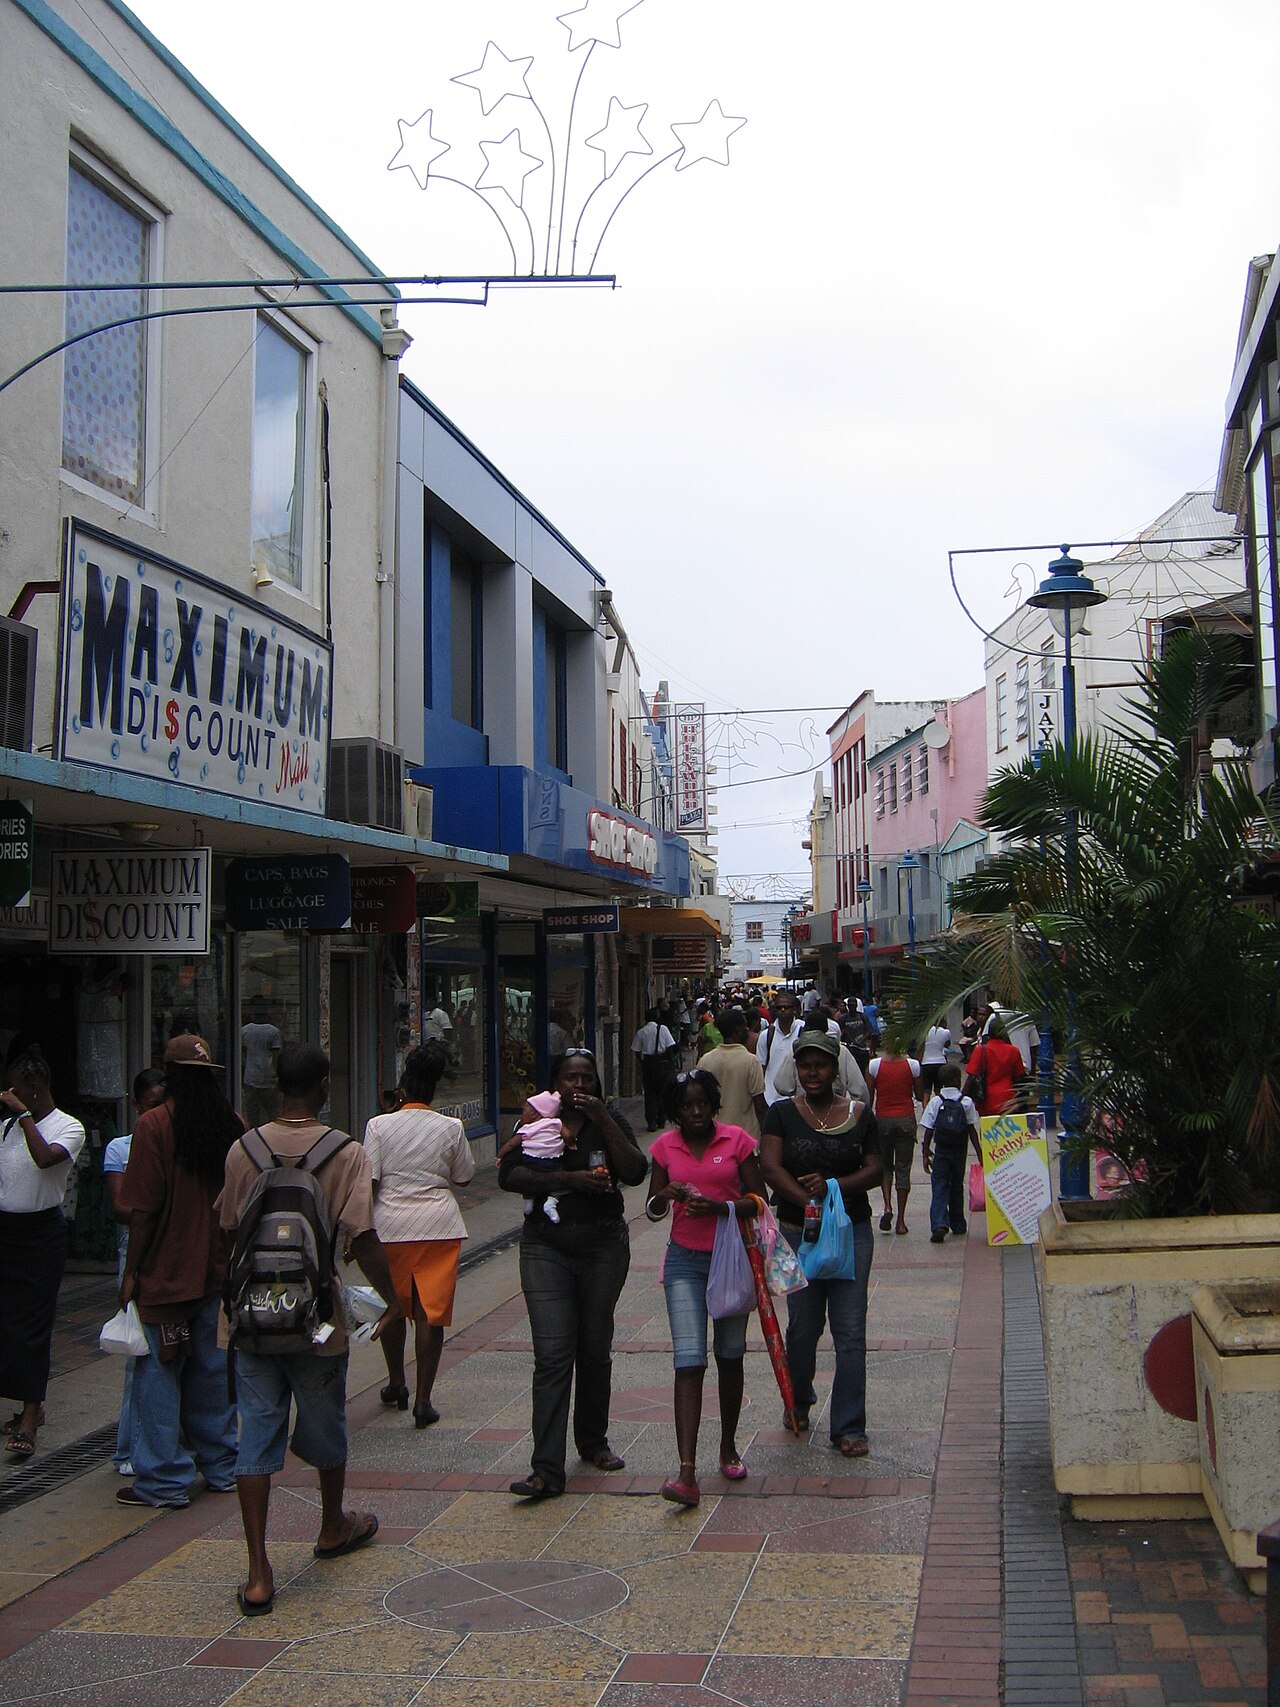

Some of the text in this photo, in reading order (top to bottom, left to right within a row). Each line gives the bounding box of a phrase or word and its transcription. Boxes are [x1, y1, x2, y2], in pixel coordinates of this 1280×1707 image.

[81, 563, 325, 741] MAXIMUM
[128, 685, 310, 794] DI$COUNT Mall
[0, 818, 26, 836] RIES
[591, 812, 658, 874] SHOE SHOP
[58, 857, 201, 896] MAXIMUM
[291, 865, 329, 880] BAGS
[282, 882, 293, 895] &
[249, 894, 326, 911] LUGGAGE
[265, 916, 309, 930] SALE
[547, 912, 615, 927] SHOE SHOP
[461, 1098, 480, 1121] BOYS
[989, 1131, 1031, 1162] Kathy's
